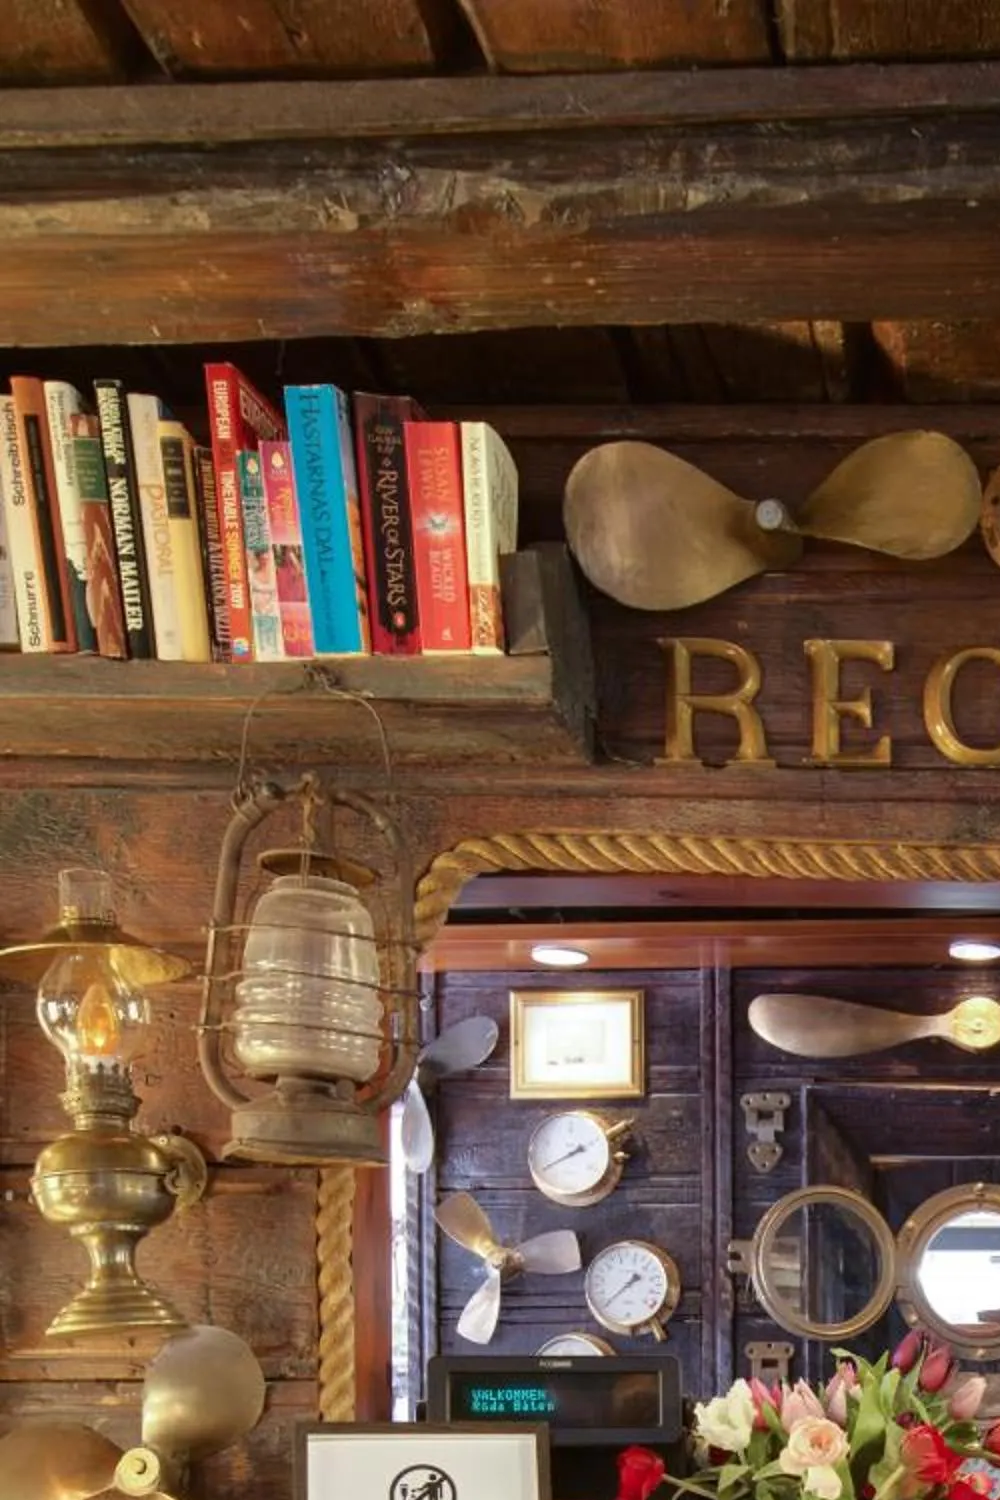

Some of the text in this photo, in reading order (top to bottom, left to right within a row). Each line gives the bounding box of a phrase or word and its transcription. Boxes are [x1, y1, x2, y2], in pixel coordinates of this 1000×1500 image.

[213, 380, 232, 439] EUROPEAN
[2, 402, 25, 507] Schreibtisch
[418, 448, 434, 499] LEWIS
[433, 446, 450, 502] SUSAN
[222, 471, 239, 531] TIMETABLE
[376, 469, 400, 534] RIVER
[109, 478, 145, 632] NORMAN MAILER
[318, 528, 335, 568] DAL
[384, 547, 407, 606] STARS
[429, 549, 443, 600] BEAUTY
[441, 547, 455, 603] WICKED
